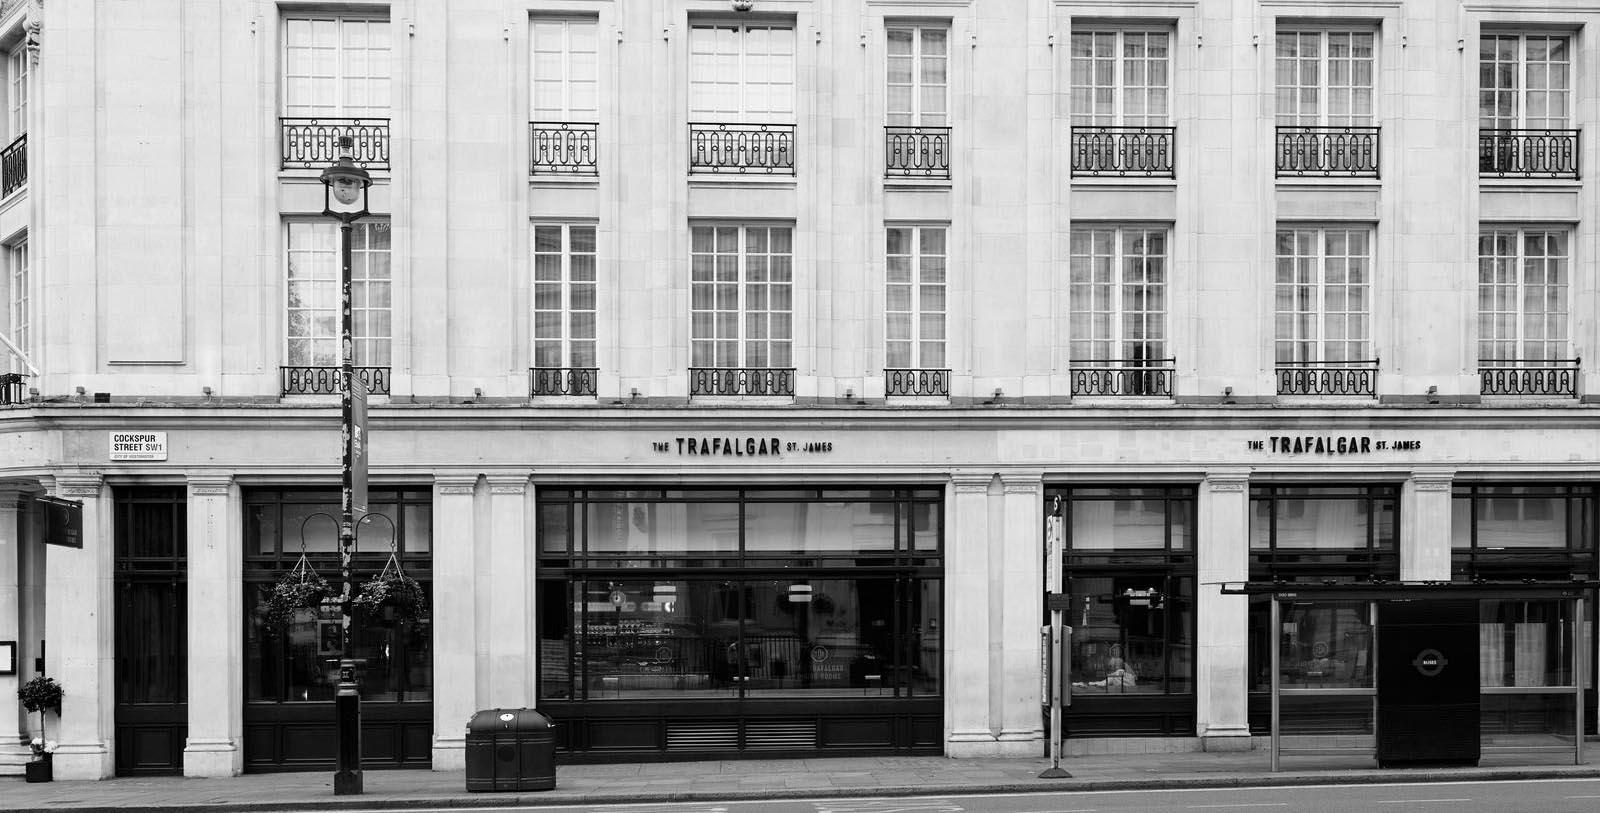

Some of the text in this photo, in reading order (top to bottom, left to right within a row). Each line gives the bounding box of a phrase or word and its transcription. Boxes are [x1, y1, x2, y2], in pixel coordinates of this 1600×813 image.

[114, 434, 156, 442] COCKSPUR
[114, 443, 162, 451] STREET SW1
[653, 437, 833, 455] THE TRAFALGAR ST. JAMES
[1248, 436, 1421, 454] THE TRAFALGAR ST. JAMES
